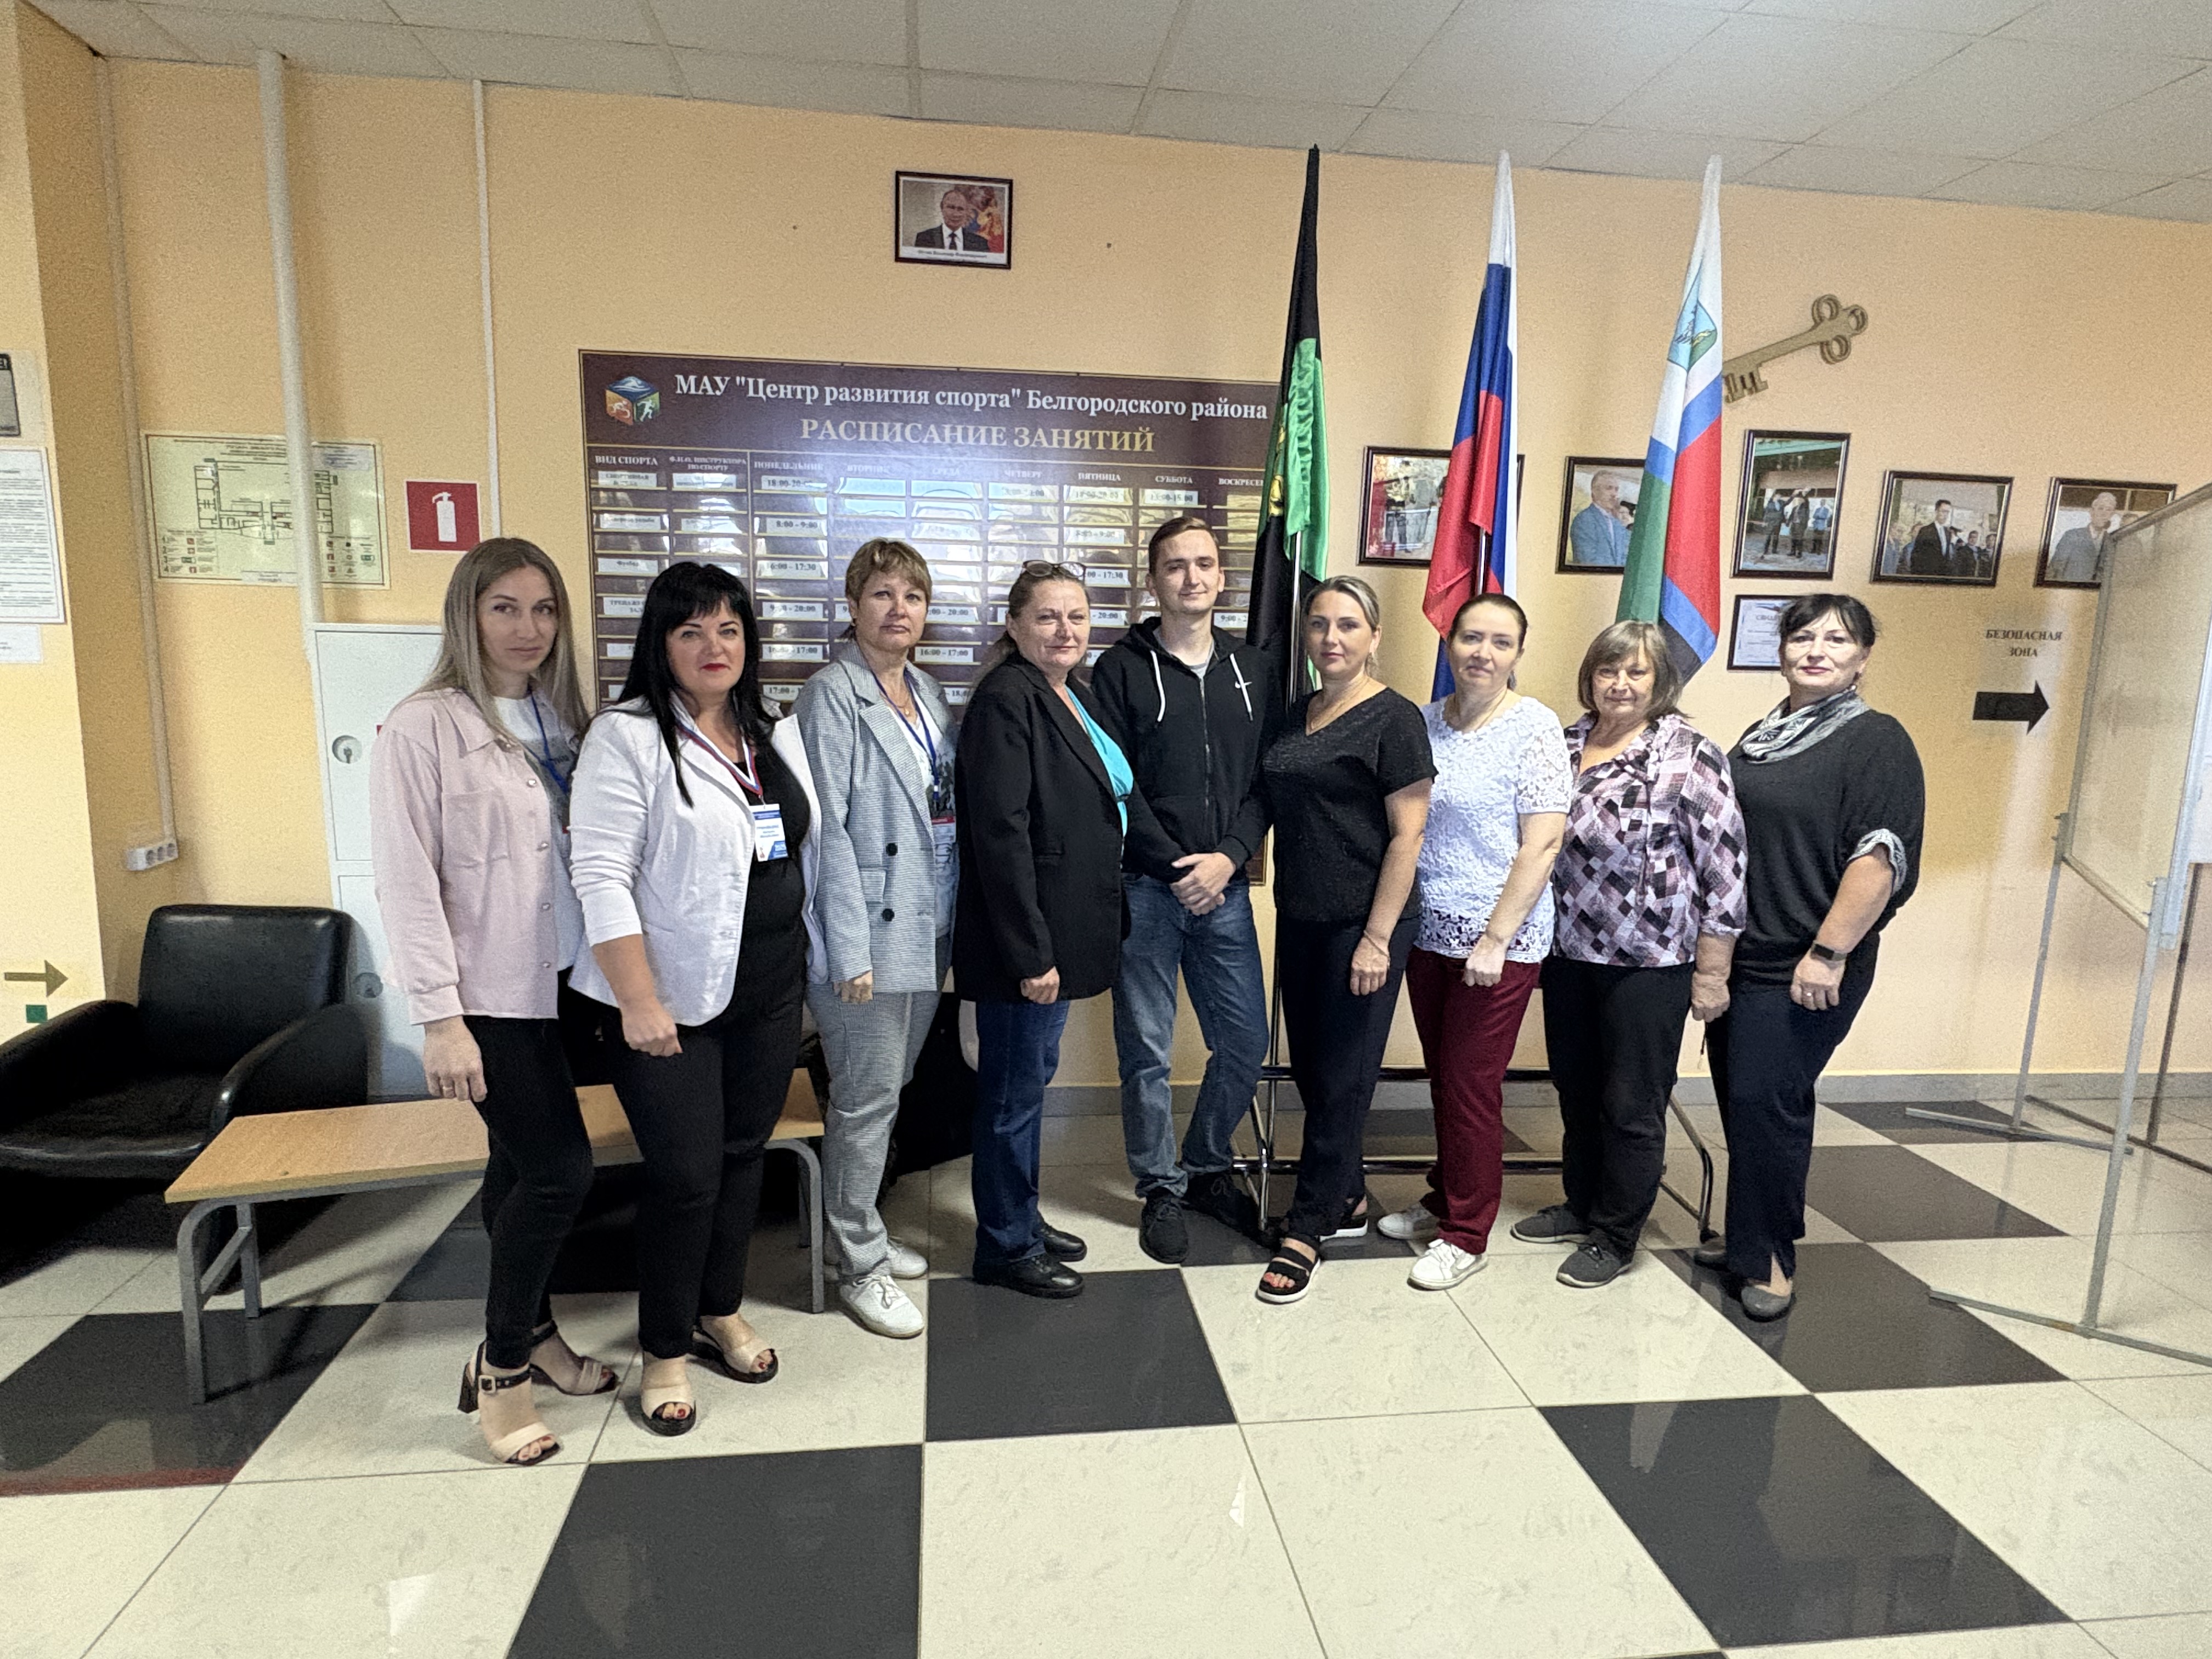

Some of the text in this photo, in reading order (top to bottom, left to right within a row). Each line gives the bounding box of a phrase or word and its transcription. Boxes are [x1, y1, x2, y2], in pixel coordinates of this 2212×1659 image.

[675, 375, 1268, 421] МАУ "Центр развития спорта" Белгородского района
[800, 419, 1155, 452] РАСПИСАНИЕ ЗАНЯТИЙ
[595, 455, 658, 466] ВИД СПОРТА
[1077, 472, 1121, 482] ПЯТНИЦА
[1155, 475, 1193, 484] СУББОТА
[1218, 477, 1264, 487] ВОСКРЕСЕ
[1985, 629, 2063, 641] БЕЗОПАСНАЯ
[2010, 646, 2038, 657] ЗОНА
